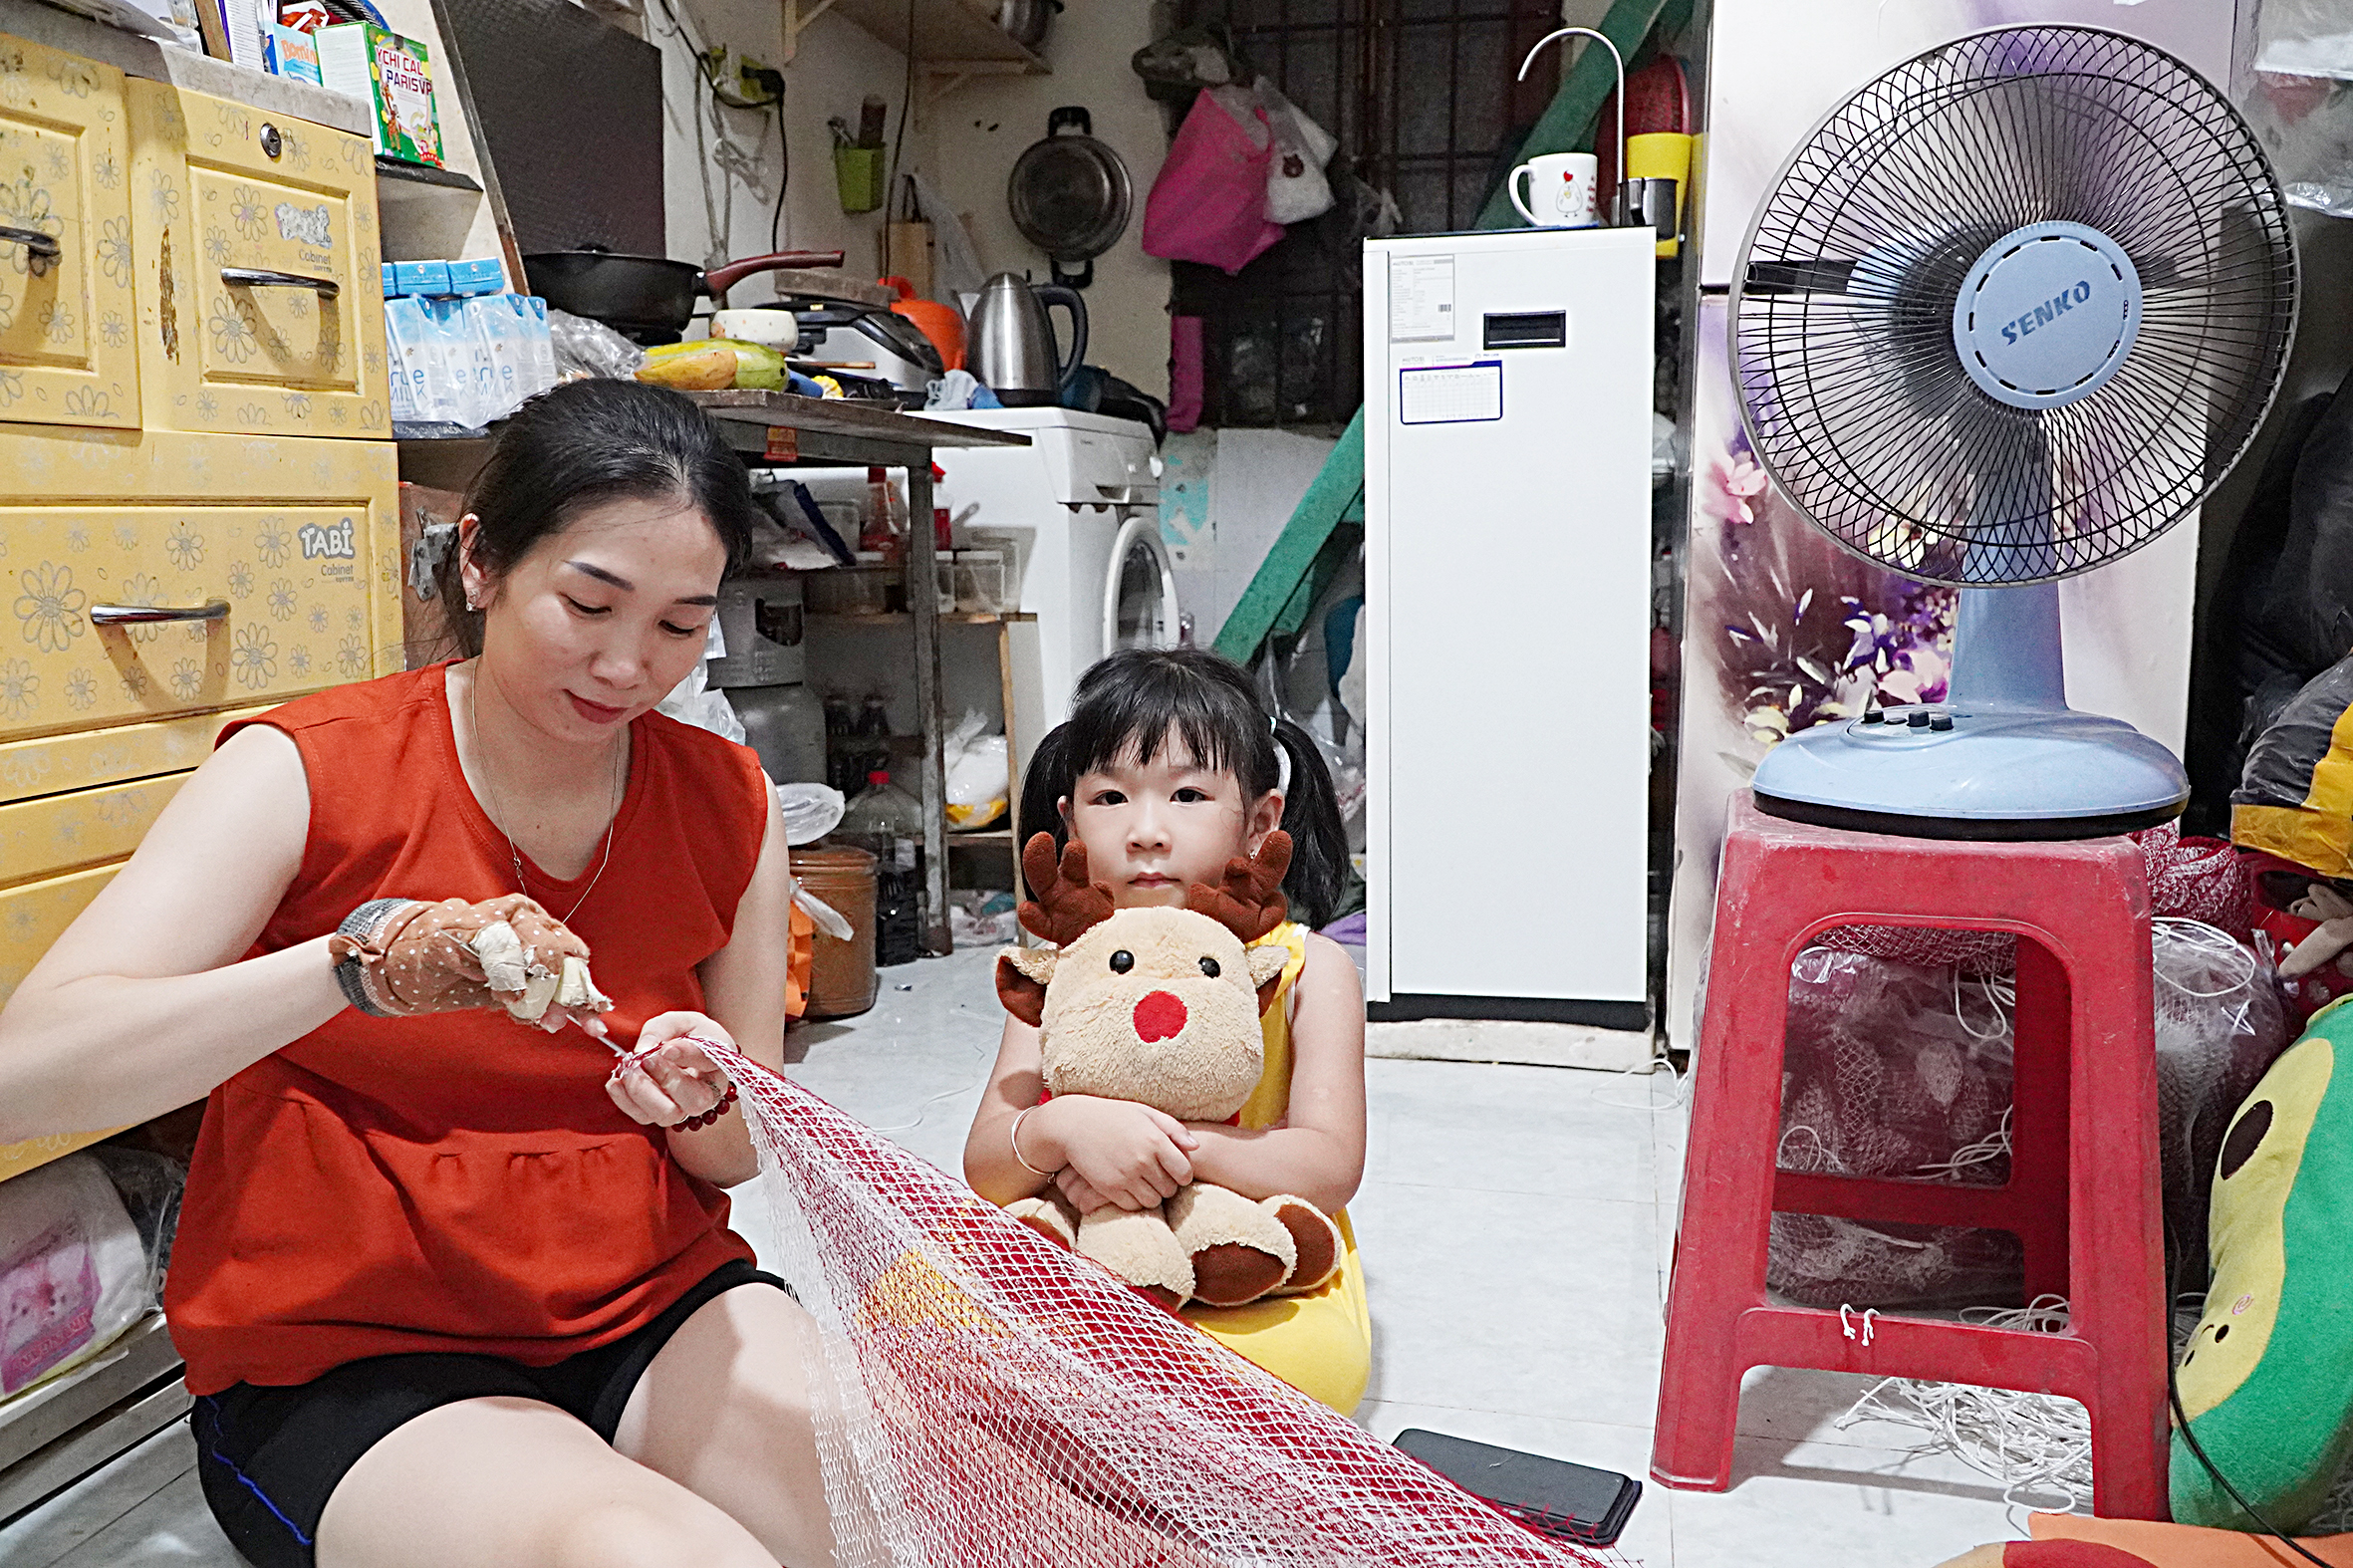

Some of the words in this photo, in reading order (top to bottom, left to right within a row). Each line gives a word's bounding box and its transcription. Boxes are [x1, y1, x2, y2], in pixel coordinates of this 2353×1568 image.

[376, 47, 400, 69] YCHI
[402, 57, 423, 76] CAL
[387, 69, 432, 96] PARISVP
[299, 248, 332, 266] Cabinet
[2000, 280, 2090, 346] SENKO
[321, 563, 354, 576] Cabinet
